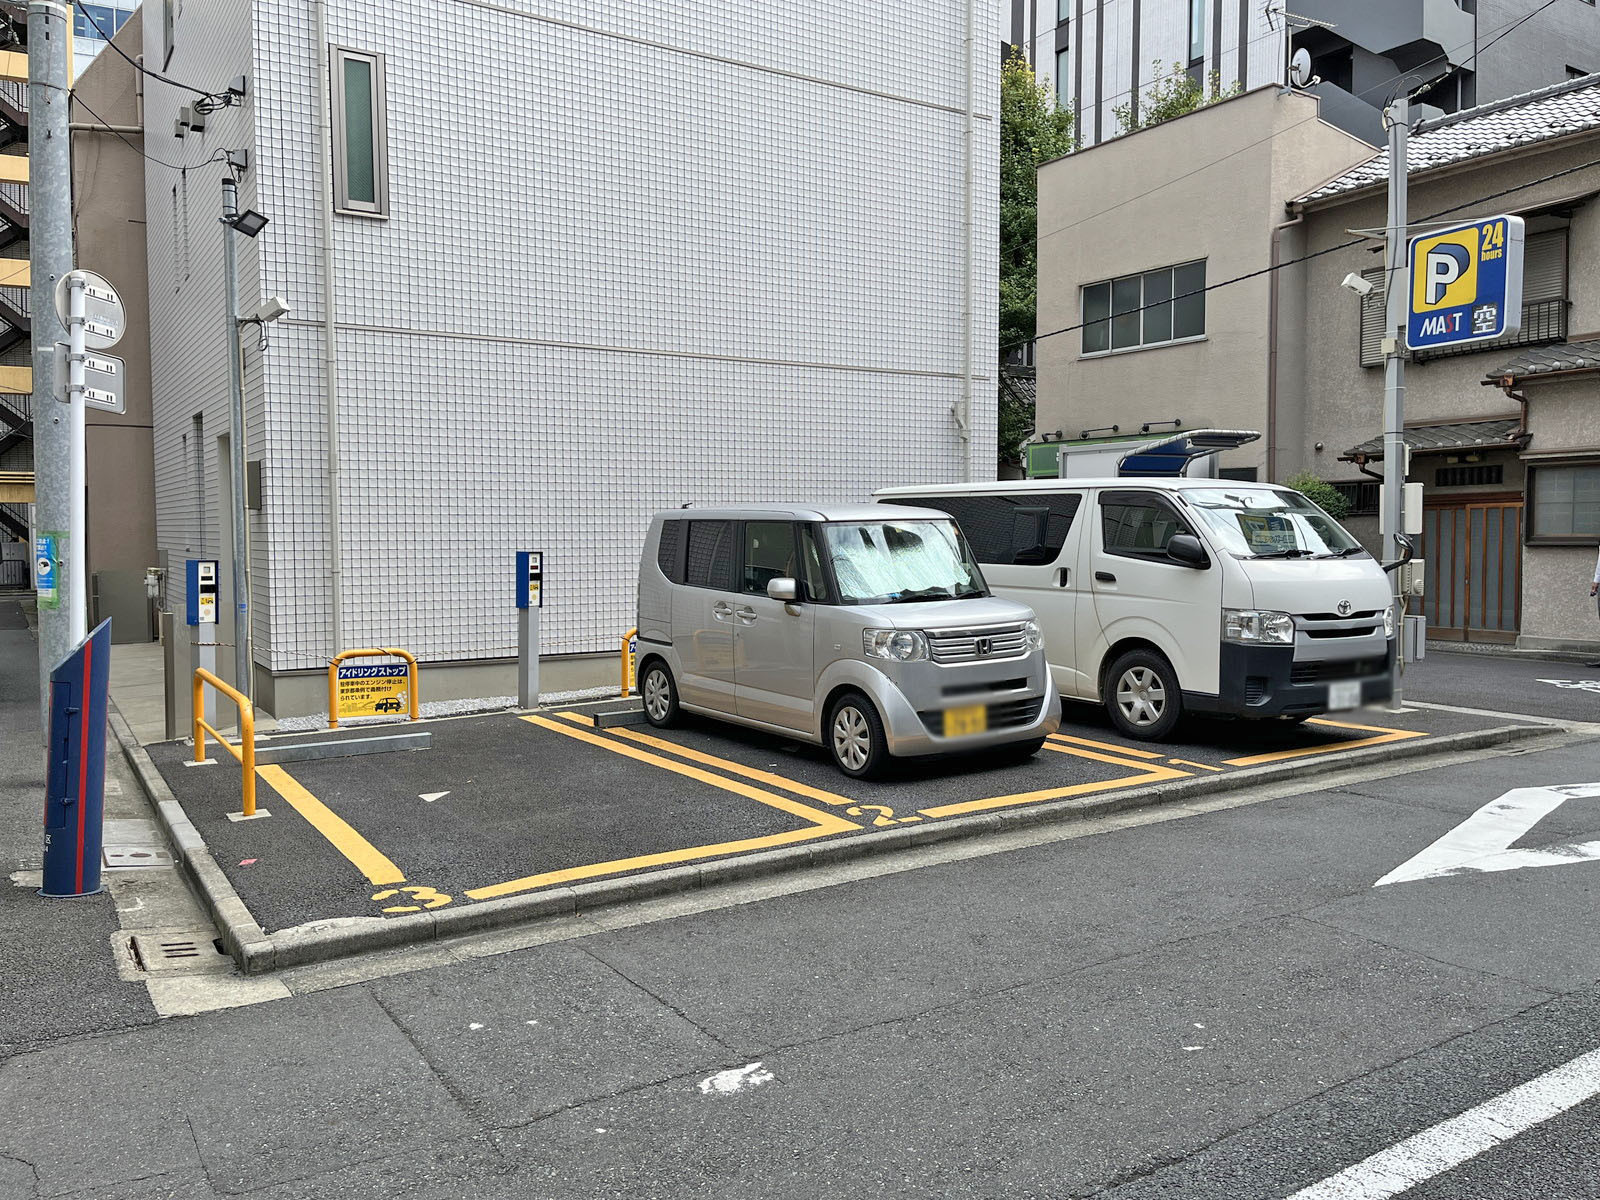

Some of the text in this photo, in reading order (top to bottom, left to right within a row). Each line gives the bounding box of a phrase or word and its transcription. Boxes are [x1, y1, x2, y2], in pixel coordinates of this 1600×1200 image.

[1481, 221, 1504, 251] 24
[1481, 247, 1503, 262] hours
[1425, 242, 1471, 305] P
[1419, 312, 1463, 338] MAST
[1472, 305, 1497, 335] 空
[339, 666, 407, 678] アイドリングストップ
[845, 804, 924, 827] 2
[371, 886, 453, 912] 3
